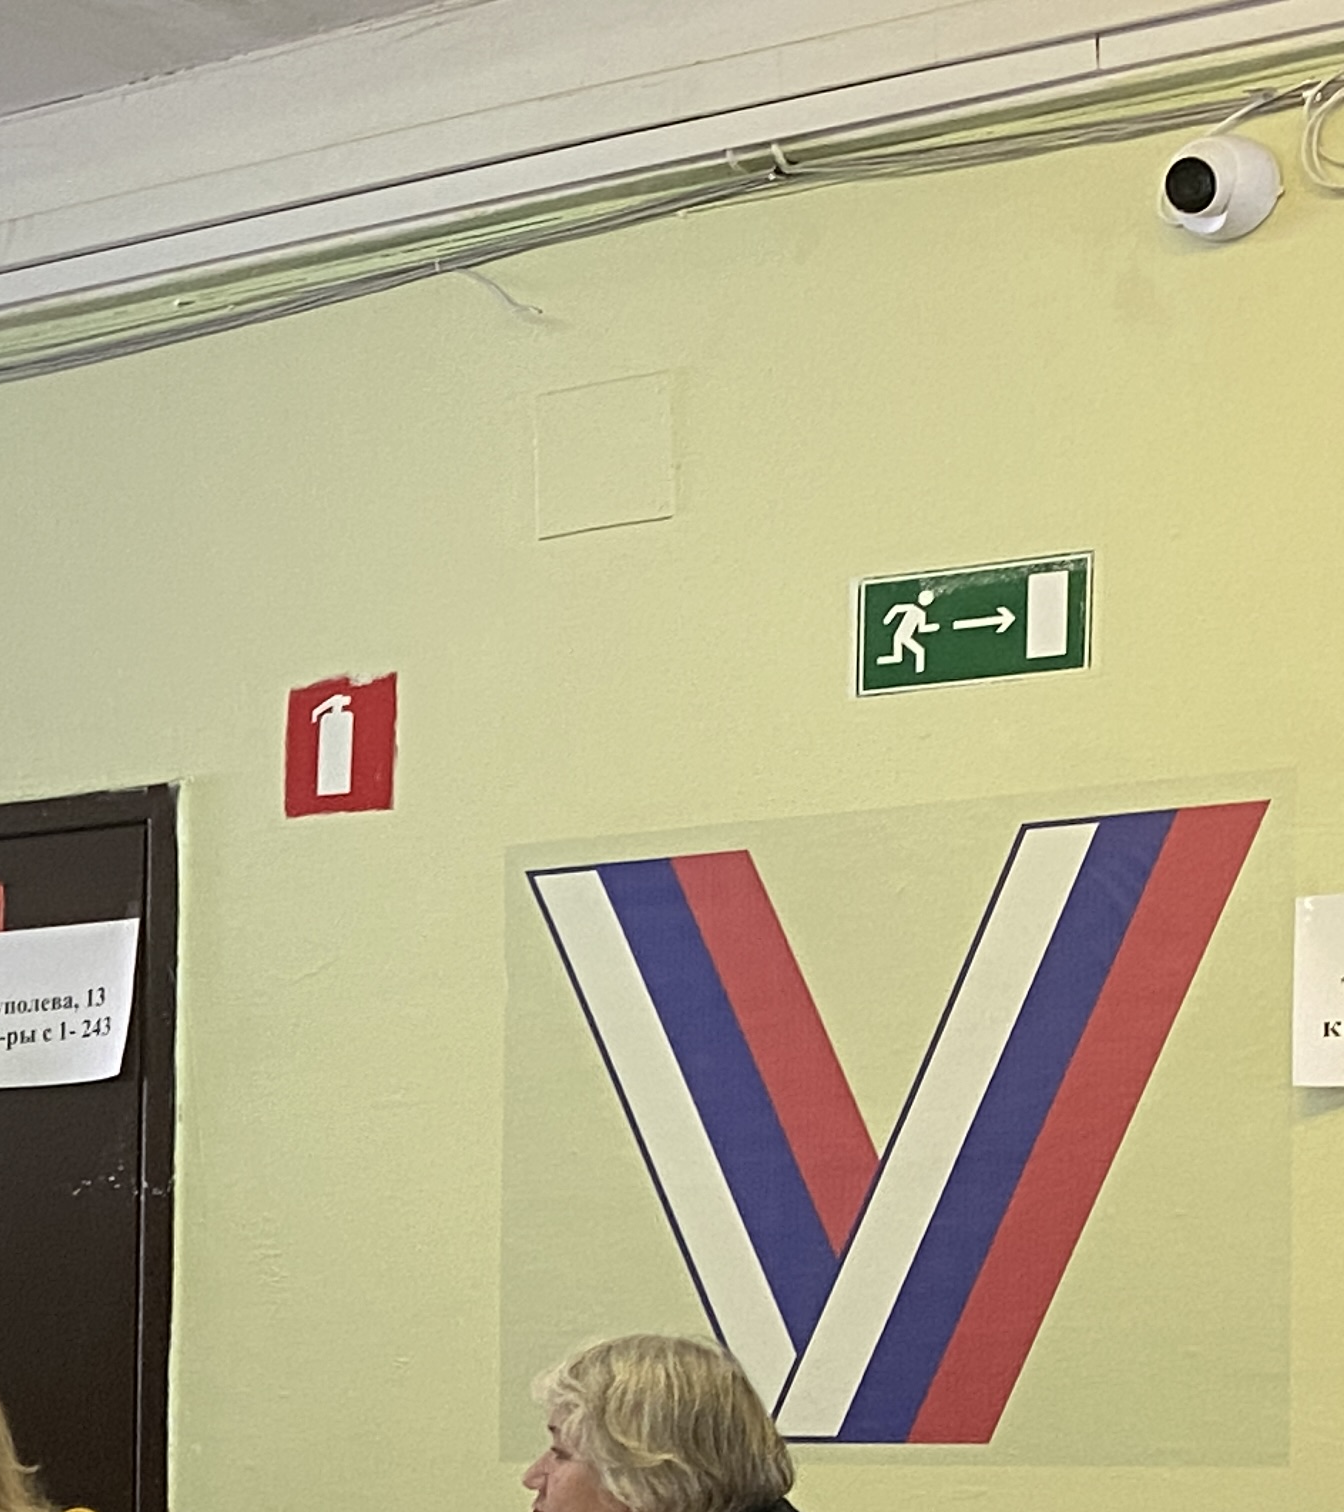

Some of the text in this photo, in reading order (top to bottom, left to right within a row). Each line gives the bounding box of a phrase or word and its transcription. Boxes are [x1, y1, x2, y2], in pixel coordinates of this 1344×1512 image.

[86, 986, 106, 1009] 13
[42, 1026, 53, 1042] с
[81, 1016, 112, 1039] 243
